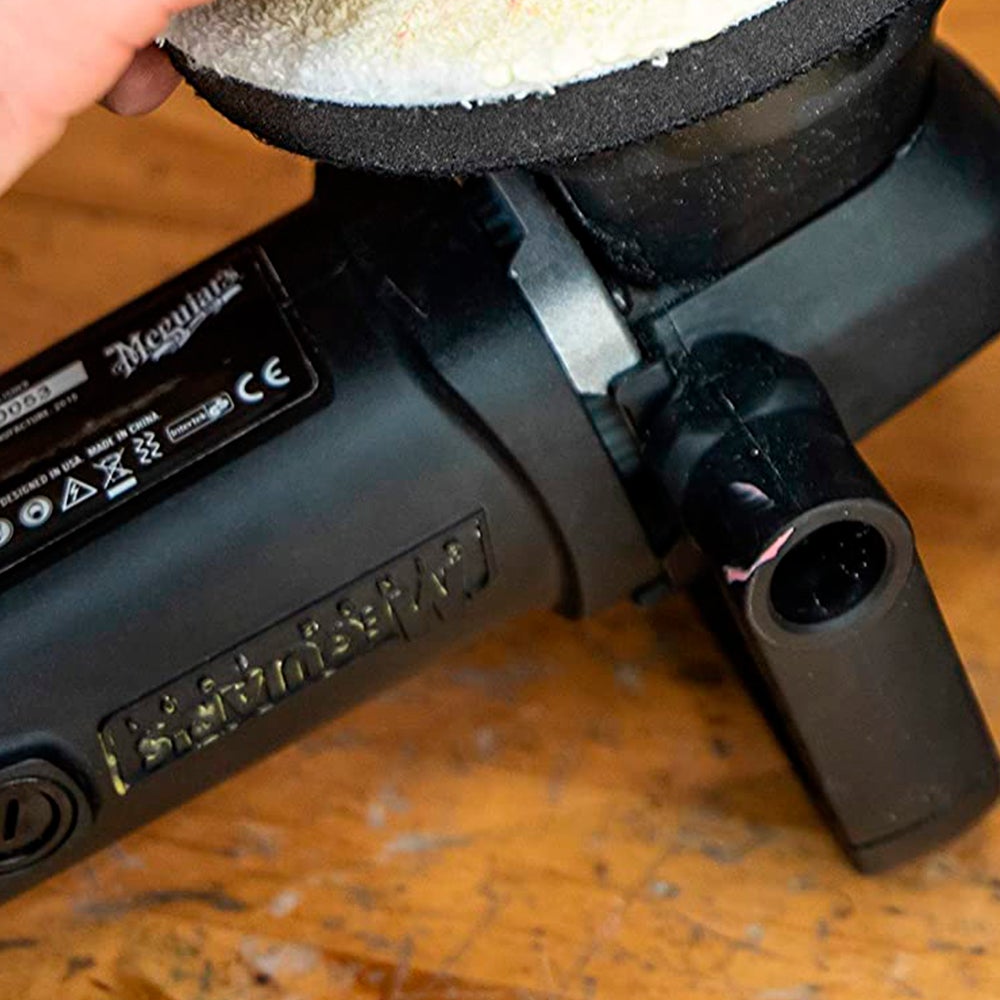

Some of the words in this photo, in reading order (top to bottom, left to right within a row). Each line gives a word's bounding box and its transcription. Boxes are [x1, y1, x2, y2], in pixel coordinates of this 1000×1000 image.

[49, 468, 62, 480] IN
[86, 438, 115, 458] MADE
[115, 430, 128, 442] IN
